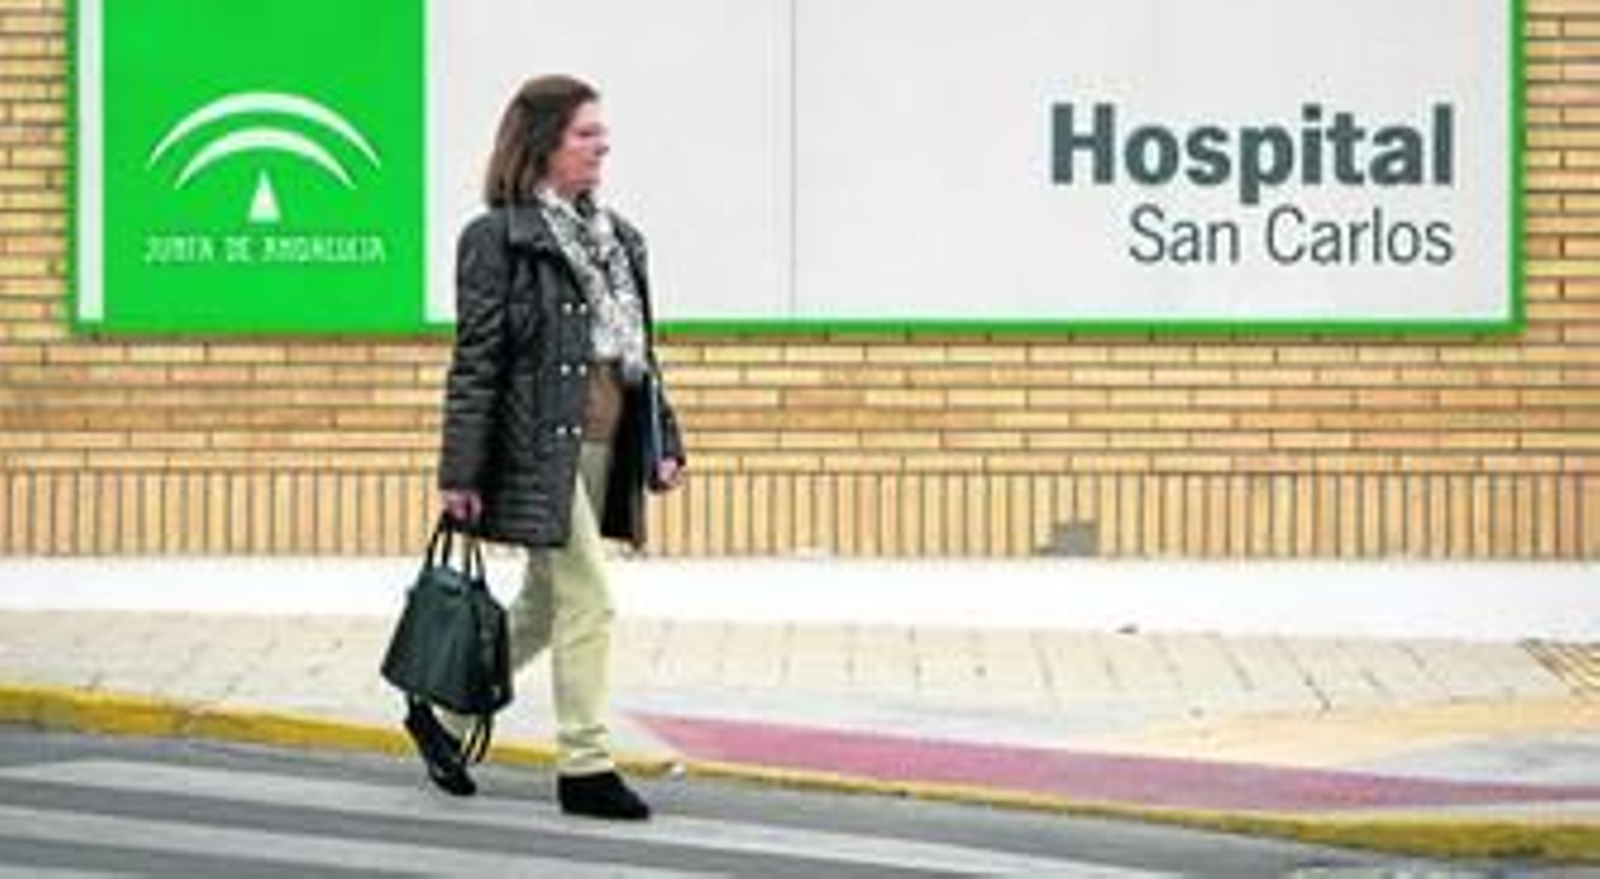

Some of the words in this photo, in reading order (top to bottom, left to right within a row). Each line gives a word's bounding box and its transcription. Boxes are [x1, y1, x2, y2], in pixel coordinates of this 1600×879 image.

[1051, 103, 1453, 204] Hospital
[144, 235, 214, 263] JUNTA
[226, 235, 250, 263] DE
[1128, 205, 1240, 264] San
[1265, 205, 1453, 264] Carlos
